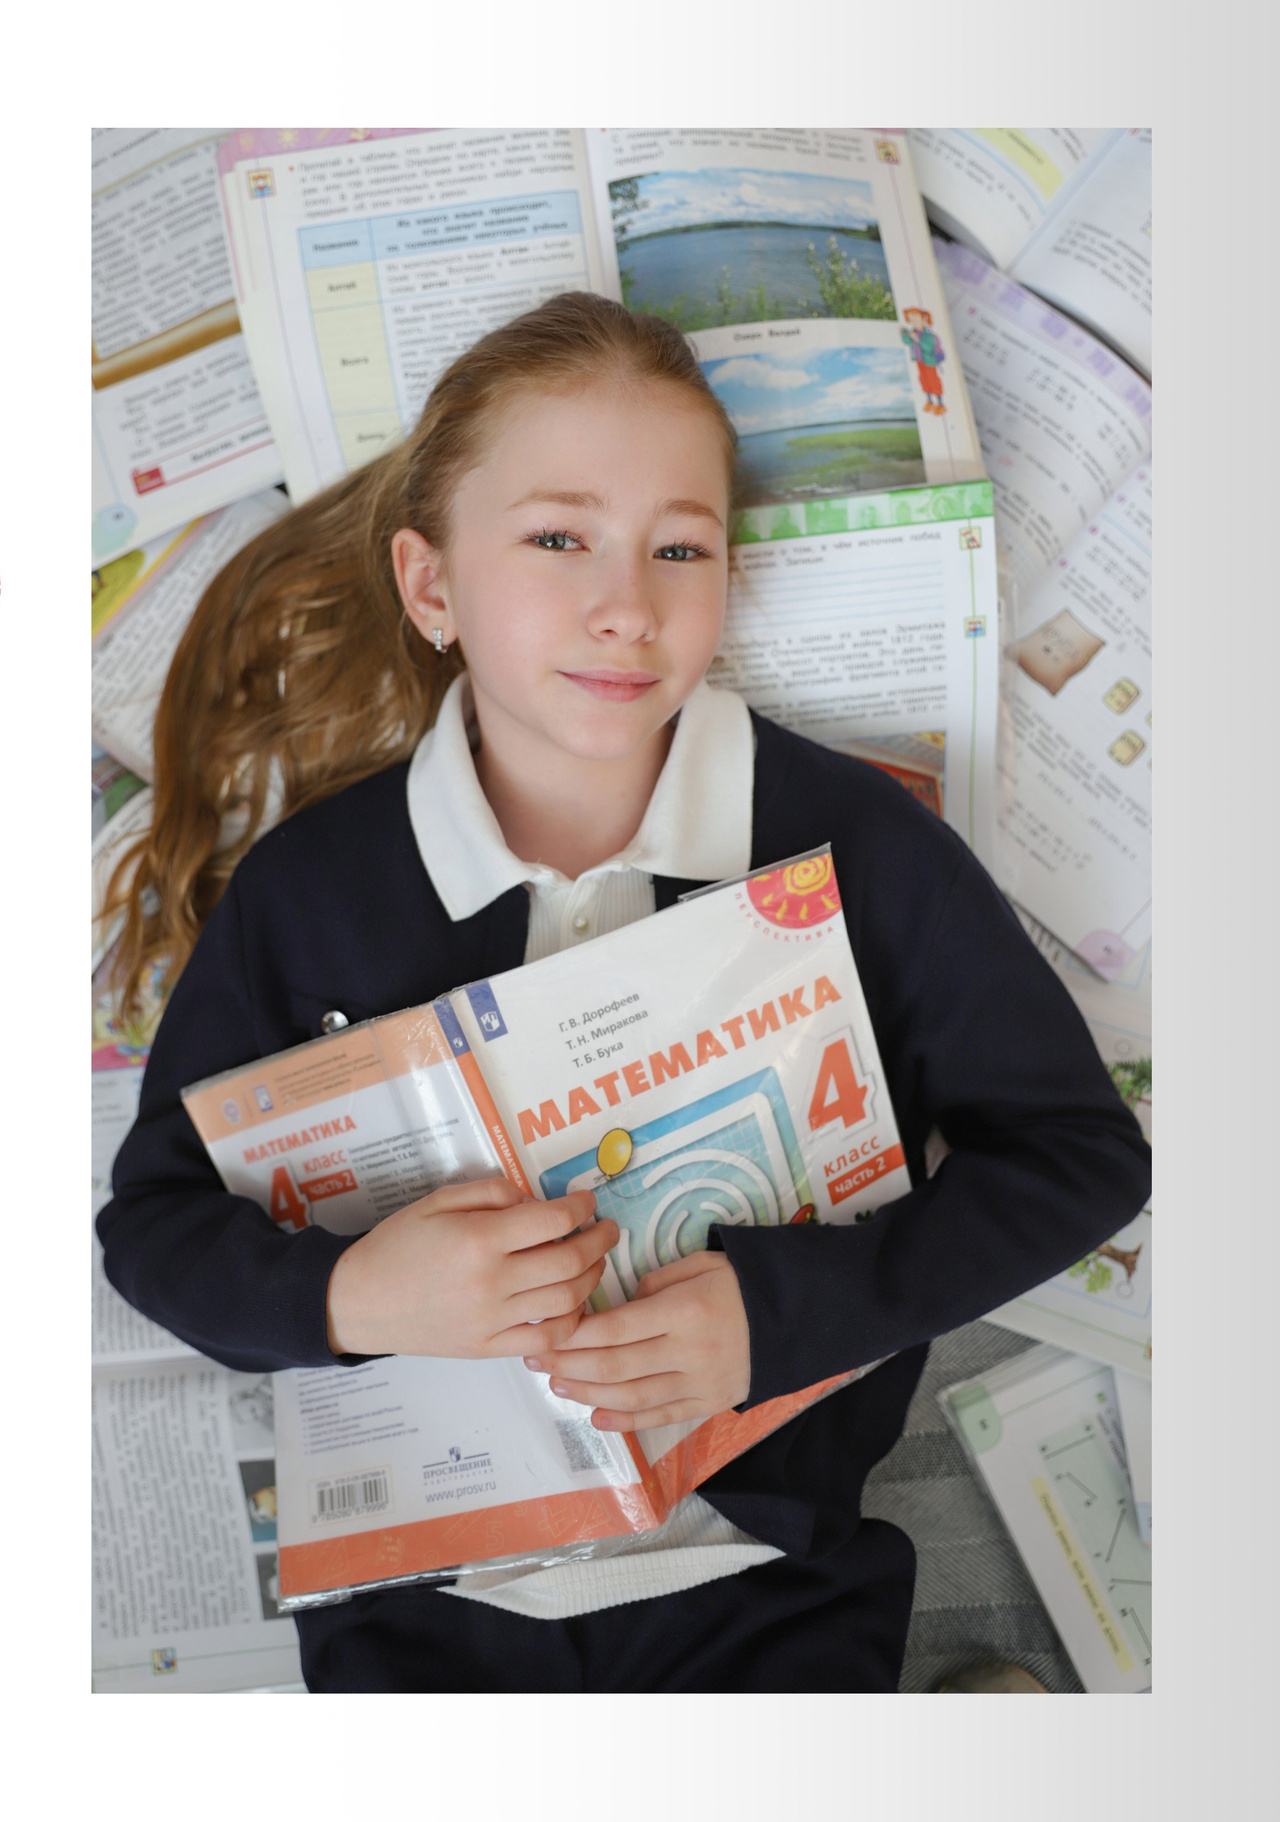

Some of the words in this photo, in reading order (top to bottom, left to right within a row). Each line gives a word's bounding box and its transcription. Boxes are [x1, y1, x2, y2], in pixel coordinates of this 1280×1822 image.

[735, 891, 834, 943] ПЕРСПЕКТИВА
[559, 1021, 568, 1033] Г.
[569, 1017, 581, 1029] В.
[582, 992, 640, 1025] Дорофеев
[565, 1039, 575, 1051] Т.
[576, 1033, 589, 1046] Н.
[590, 1009, 649, 1042] Миракова
[517, 975, 842, 1145] МАТЕМАТИКА
[572, 1057, 583, 1068] Т.
[584, 1051, 597, 1064] Б.
[597, 1041, 624, 1061] Бука
[807, 1037, 869, 1132] 4
[243, 1115, 357, 1164] МАТЕМАТИКА
[492, 1124, 524, 1188] МАТЕМАТИКА
[824, 1136, 880, 1177] класс
[303, 1149, 348, 1174] класс
[308, 1172, 342, 1196] часть
[343, 1168, 355, 1187] 2
[835, 1163, 873, 1195] часть
[875, 1156, 888, 1175] 2
[270, 1165, 309, 1231] 4
[423, 1458, 493, 1481] ПРОСВЕЩЕНИЕ
[426, 1480, 497, 1504] www.prosv.ru
